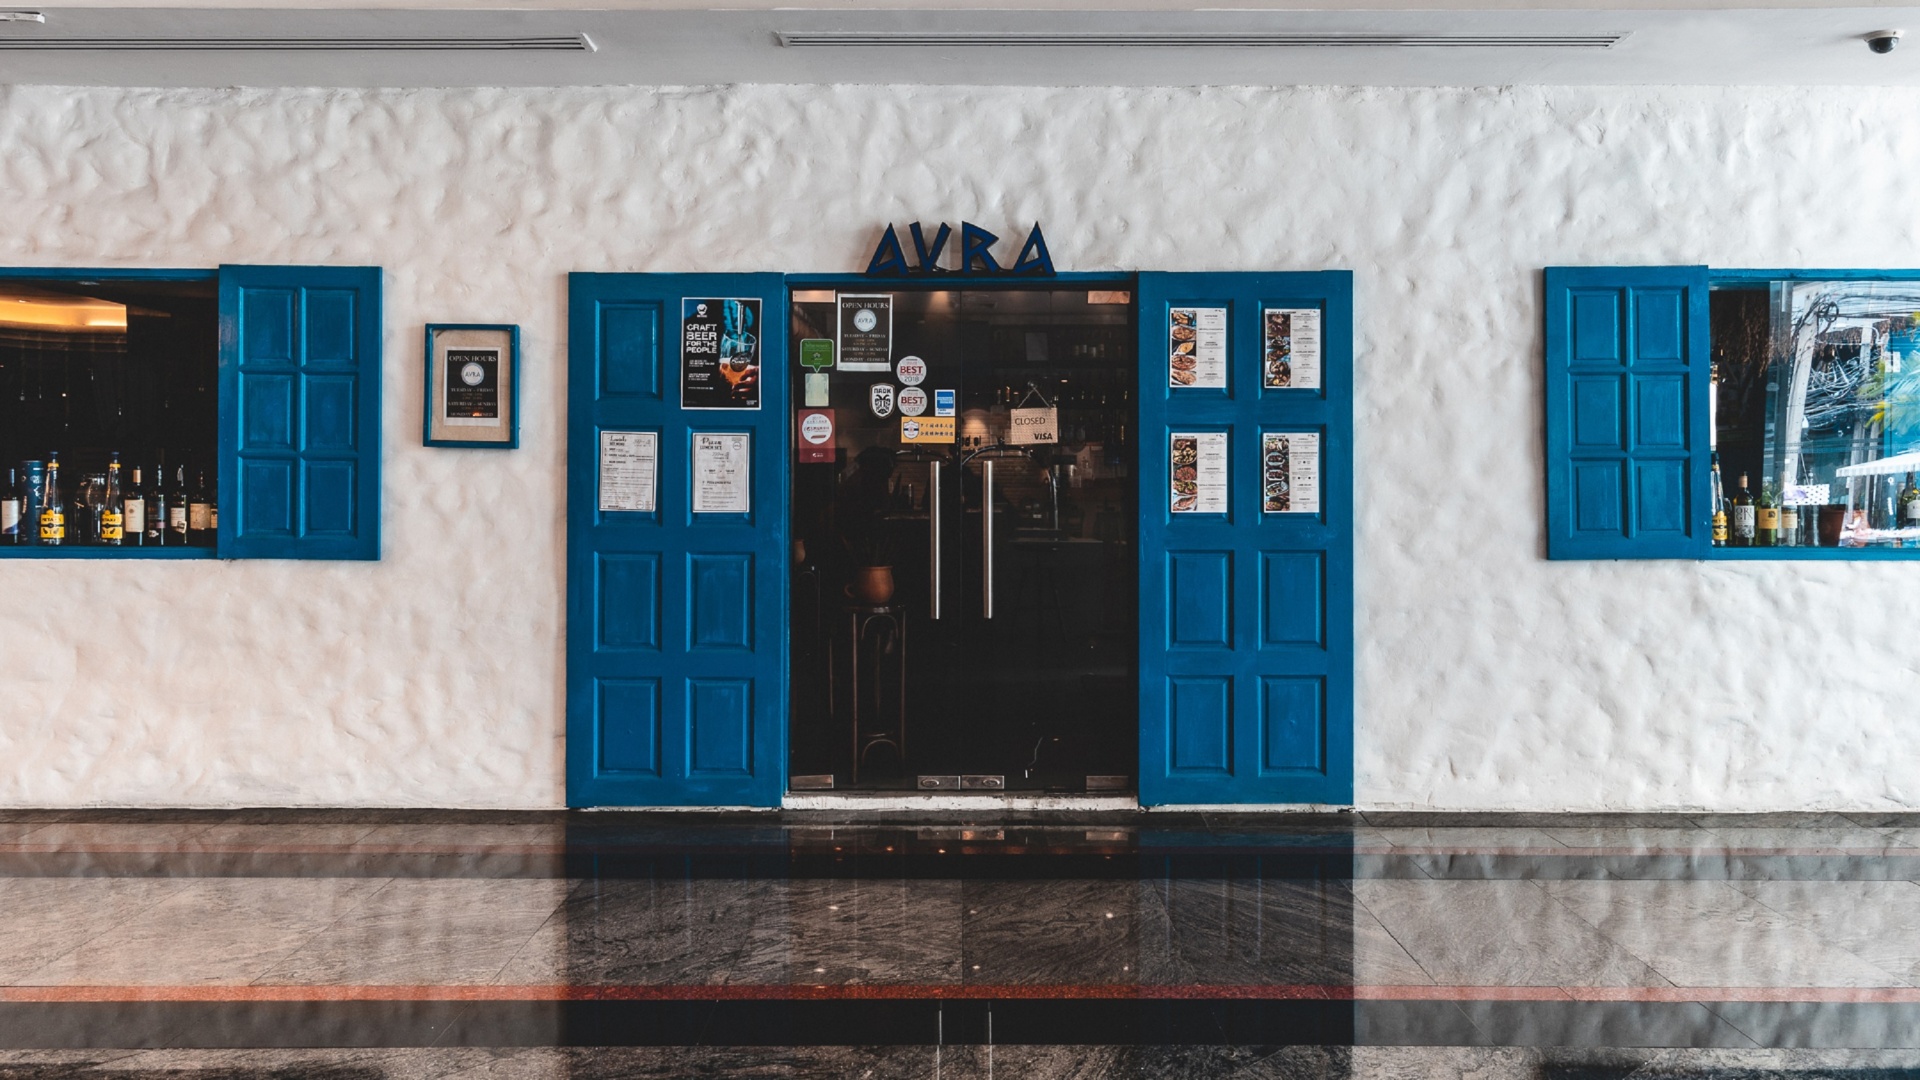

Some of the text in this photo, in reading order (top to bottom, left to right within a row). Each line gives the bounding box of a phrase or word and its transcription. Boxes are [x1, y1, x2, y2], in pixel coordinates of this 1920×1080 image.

[866, 220, 1057, 276] AVRA
[686, 332, 717, 340] BEER
[900, 366, 923, 374] BEST
[900, 396, 925, 404] BEST
[1015, 417, 1045, 425] CLOSED
[1034, 432, 1053, 440] VISA
